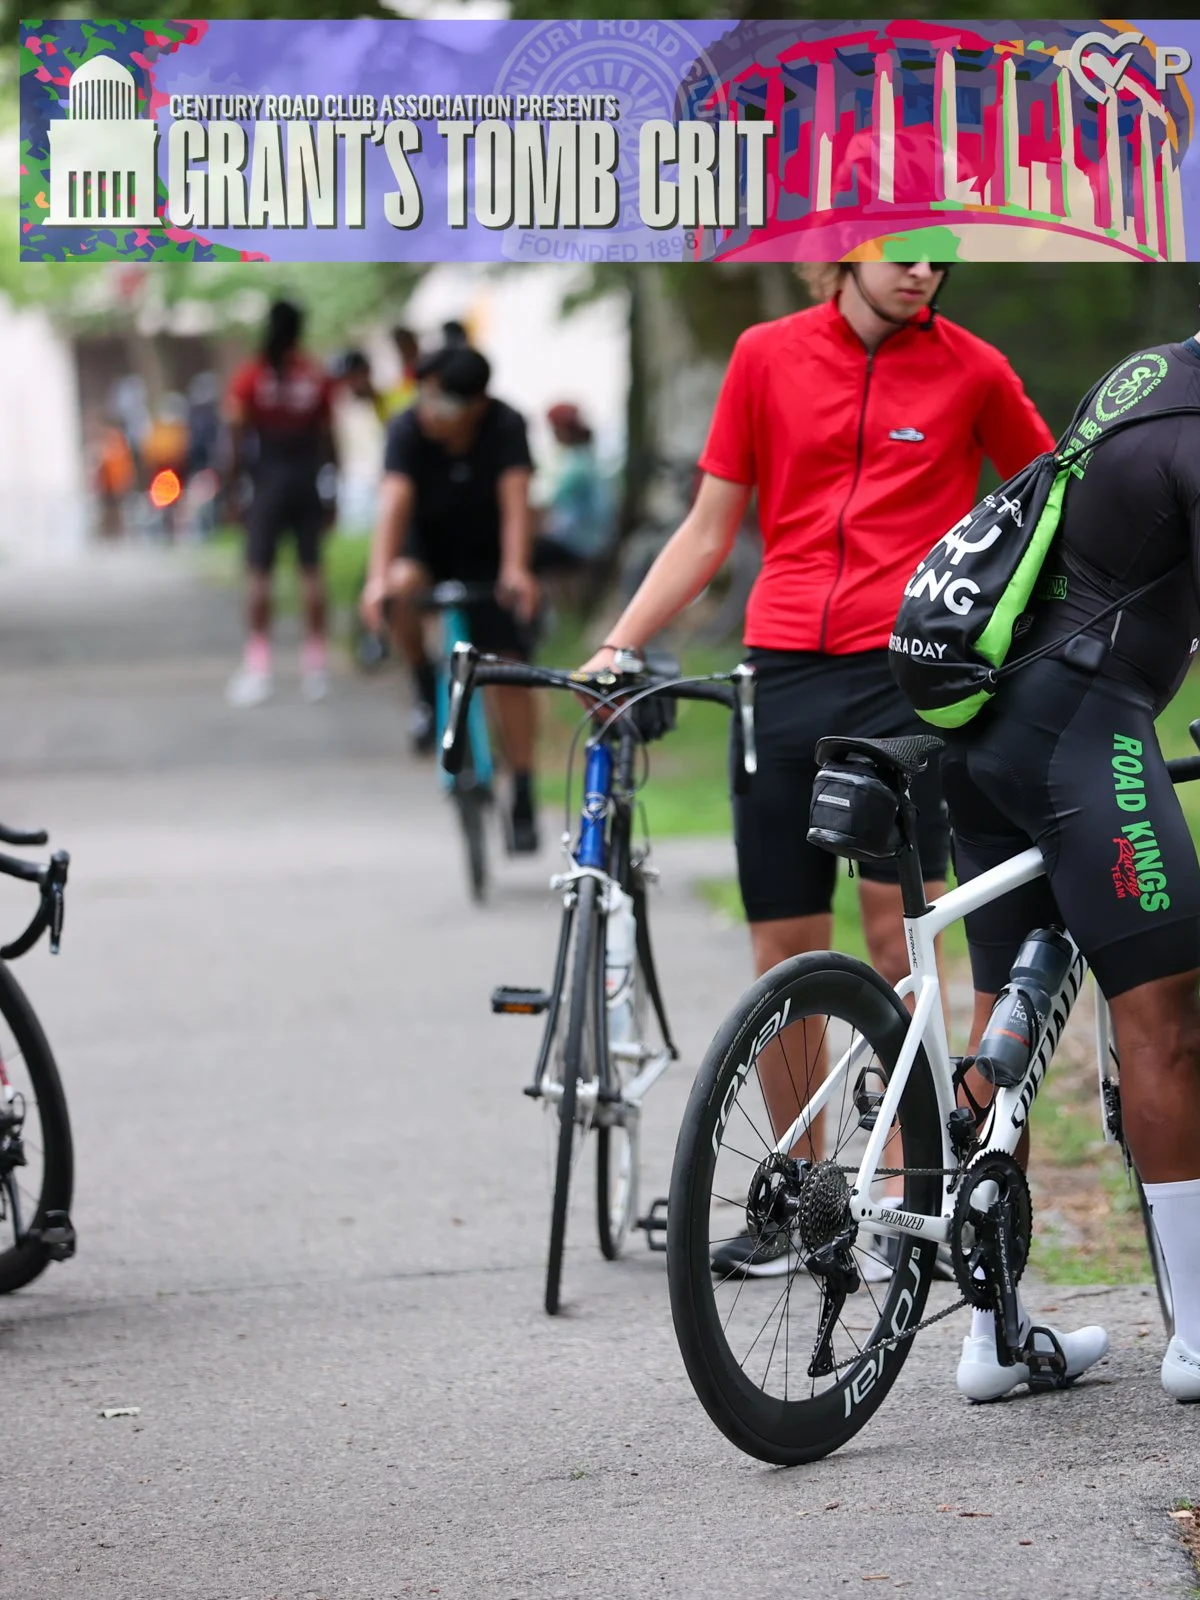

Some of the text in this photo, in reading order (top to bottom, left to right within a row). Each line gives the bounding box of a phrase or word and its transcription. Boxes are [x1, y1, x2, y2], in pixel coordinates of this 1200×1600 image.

[910, 638, 948, 660] DAY
[1111, 733, 1171, 912] ROAD KINGS
[1111, 865, 1127, 899] TEAM
[1112, 837, 1141, 898] Racing
[907, 926, 919, 969] TARMAC
[878, 1208, 925, 1231] SPECIALIZED
